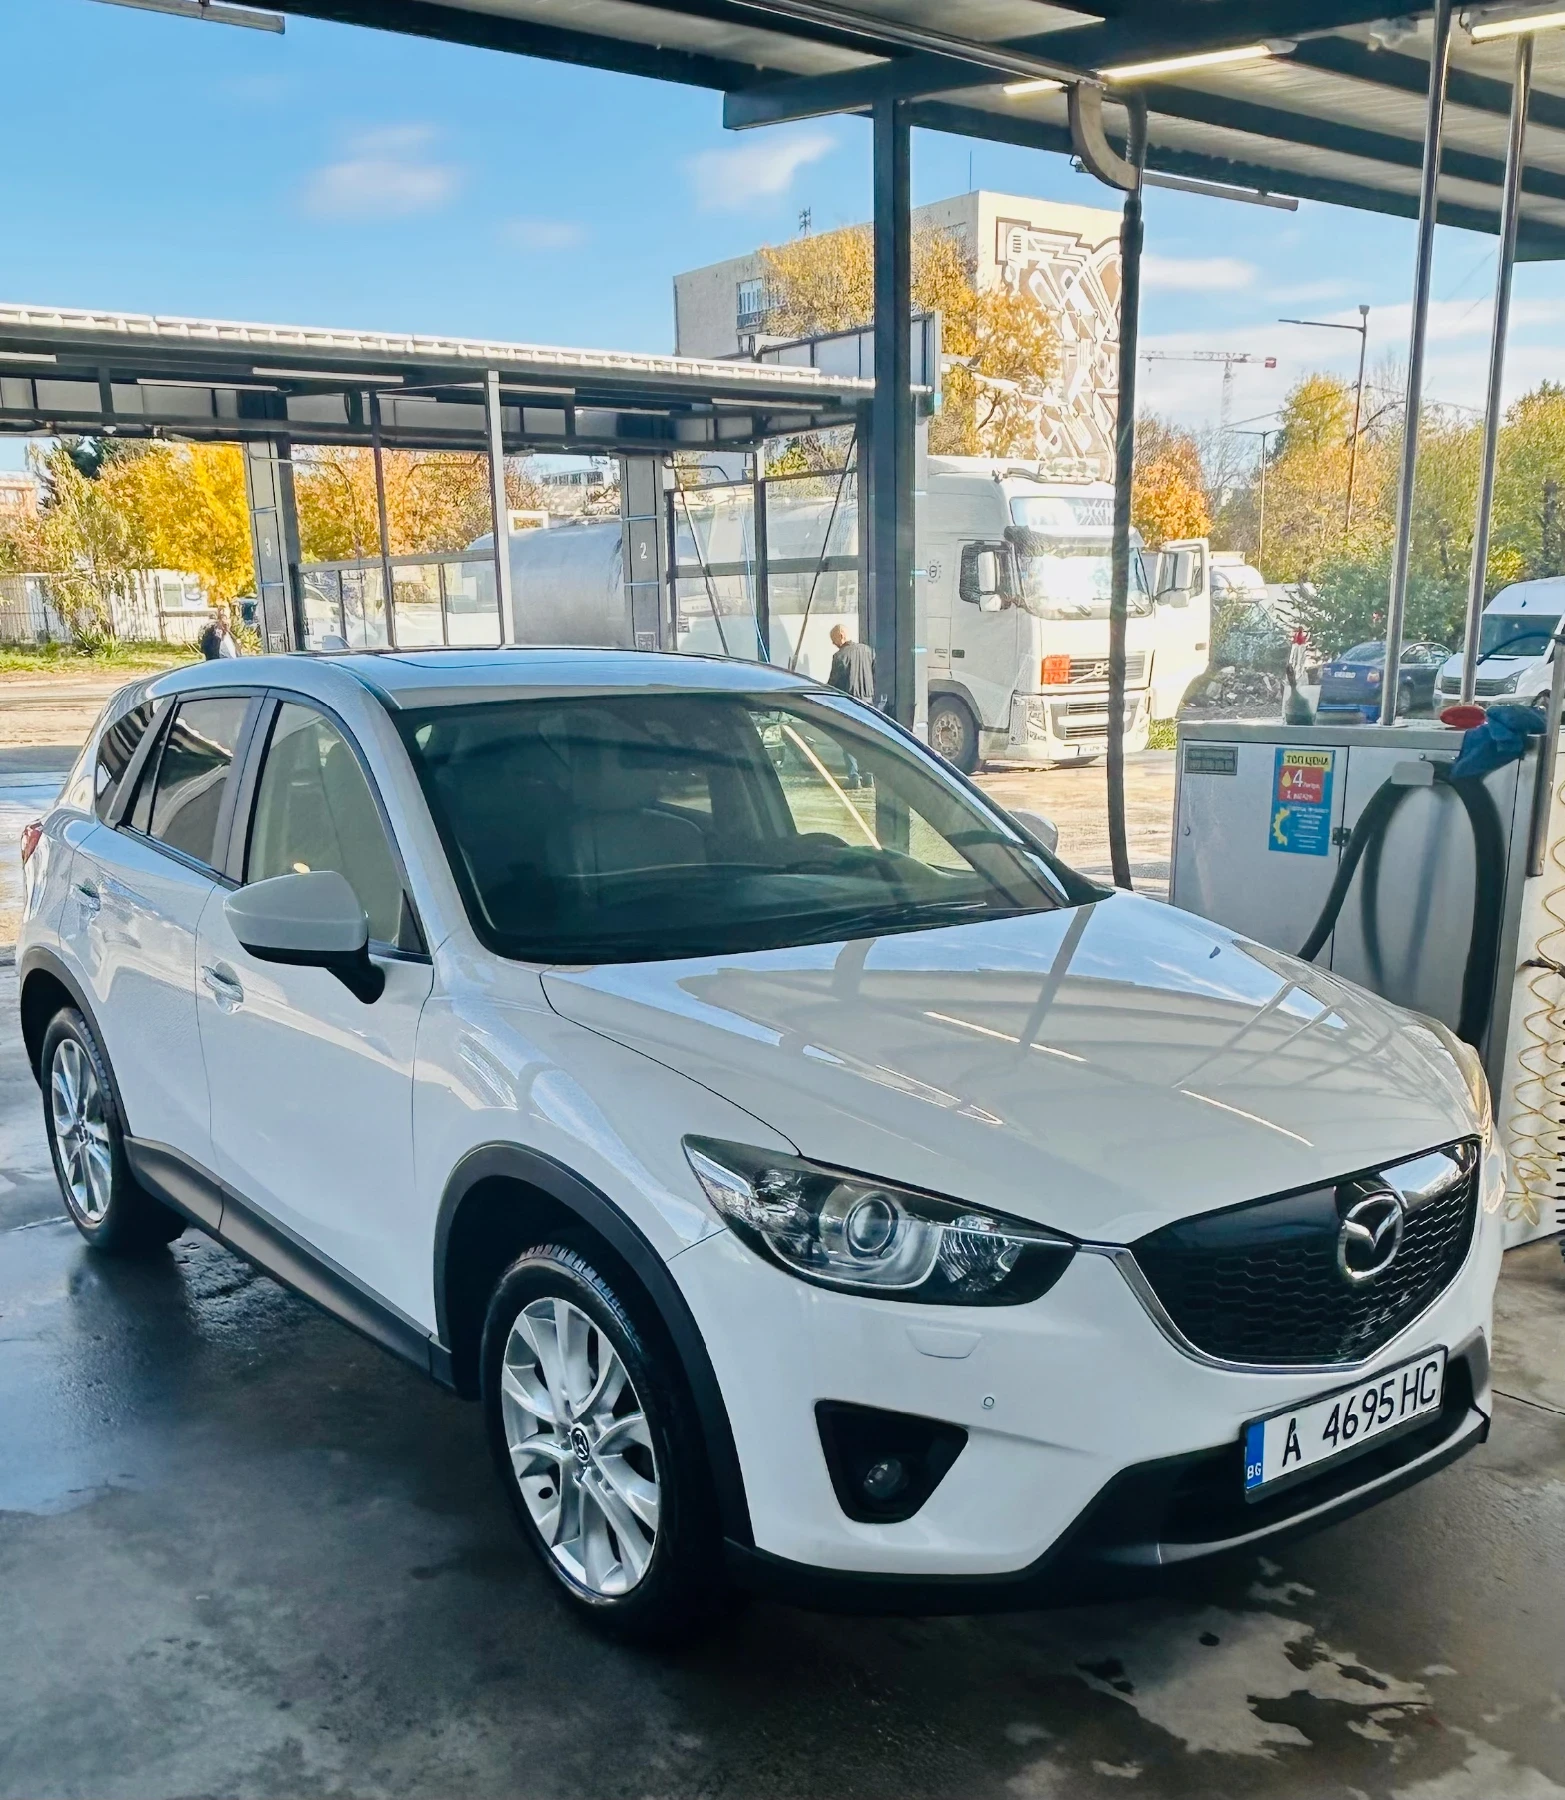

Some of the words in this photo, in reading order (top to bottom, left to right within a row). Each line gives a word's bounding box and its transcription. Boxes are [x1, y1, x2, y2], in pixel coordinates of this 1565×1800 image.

[265, 537, 272, 557] 3
[640, 542, 648, 559] 2
[1292, 769, 1303, 788] 4
[1282, 1417, 1302, 1467] A
[1322, 1378, 1395, 1448] 4695
[1246, 1462, 1262, 1480] BG
